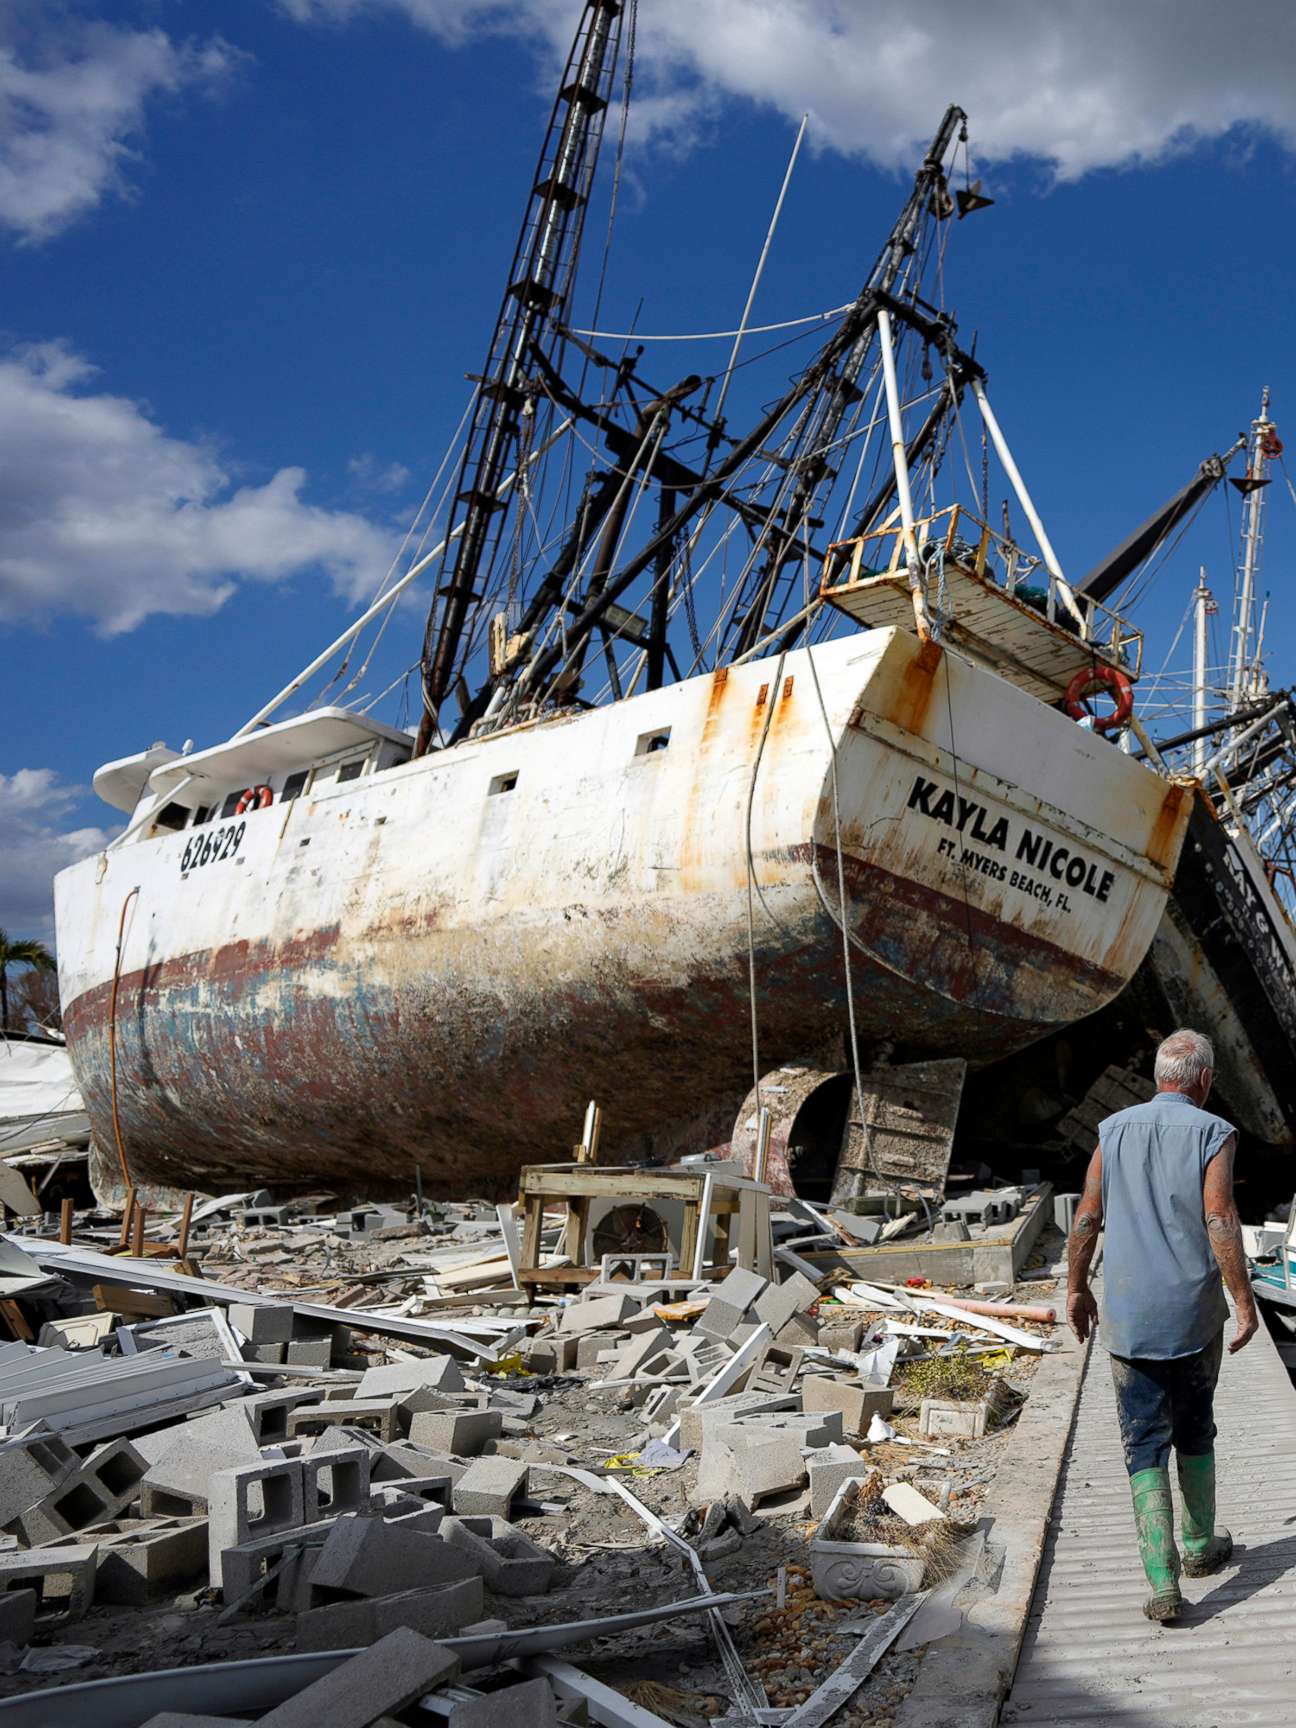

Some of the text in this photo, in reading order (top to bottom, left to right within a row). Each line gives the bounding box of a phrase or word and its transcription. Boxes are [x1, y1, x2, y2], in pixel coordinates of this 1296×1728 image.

[906, 775, 1115, 903] KAYLA NICOLE
[936, 837, 1072, 914] FT. MYERS BEACH, FL.
